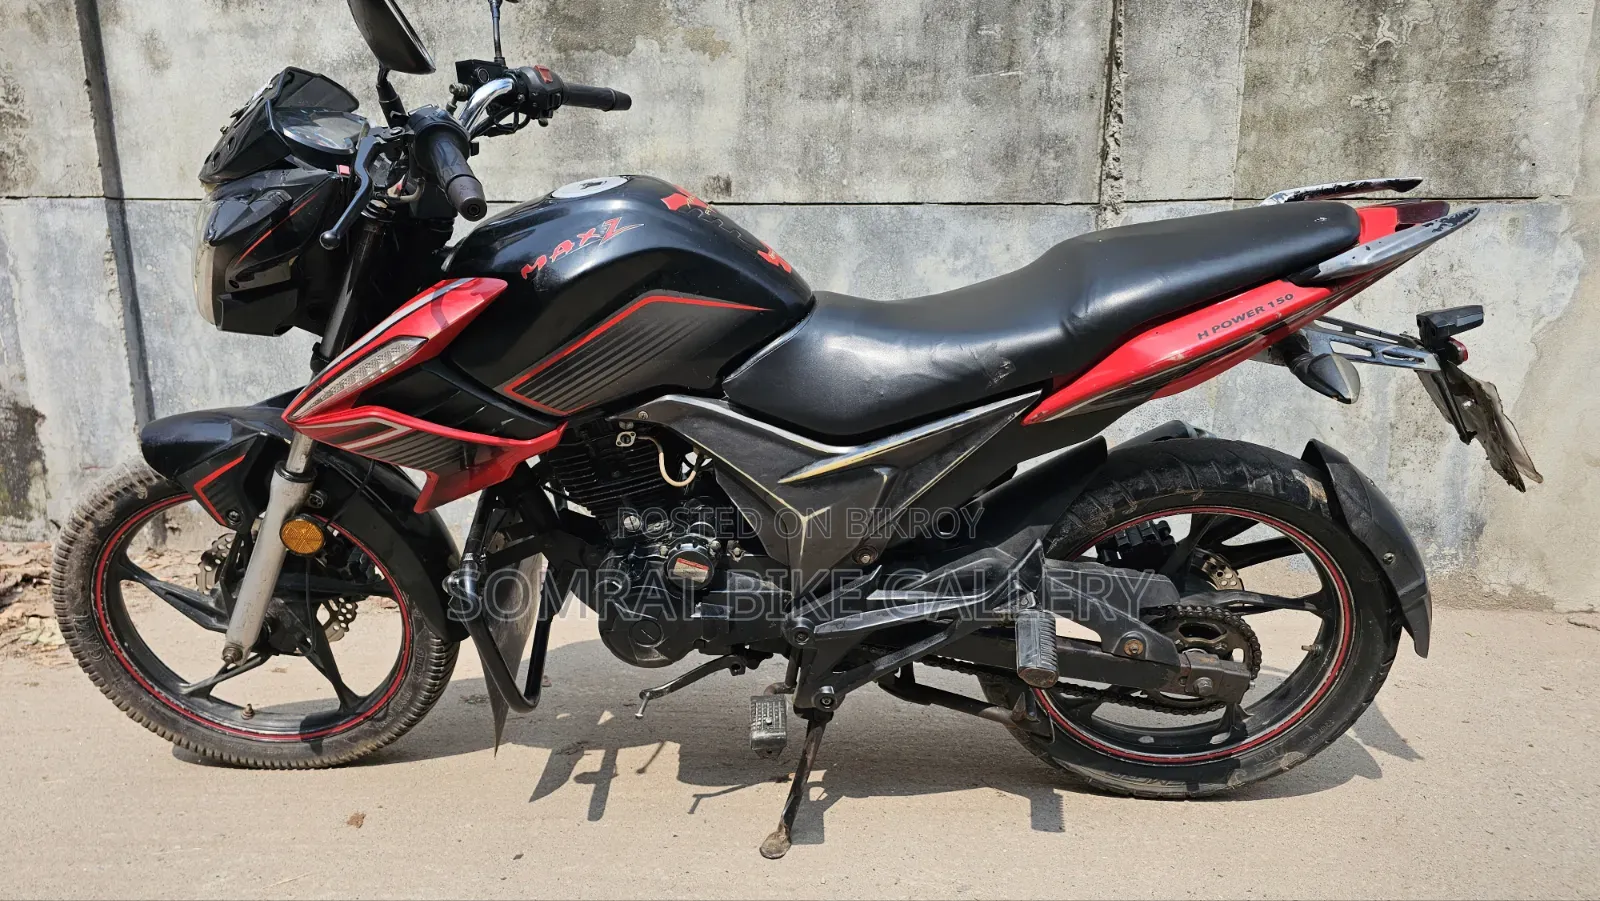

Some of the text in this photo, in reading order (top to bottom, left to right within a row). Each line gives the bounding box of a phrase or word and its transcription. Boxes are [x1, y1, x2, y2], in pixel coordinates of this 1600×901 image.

[520, 217, 645, 279] MAXZ
[1197, 293, 1294, 340] H POWER 150
